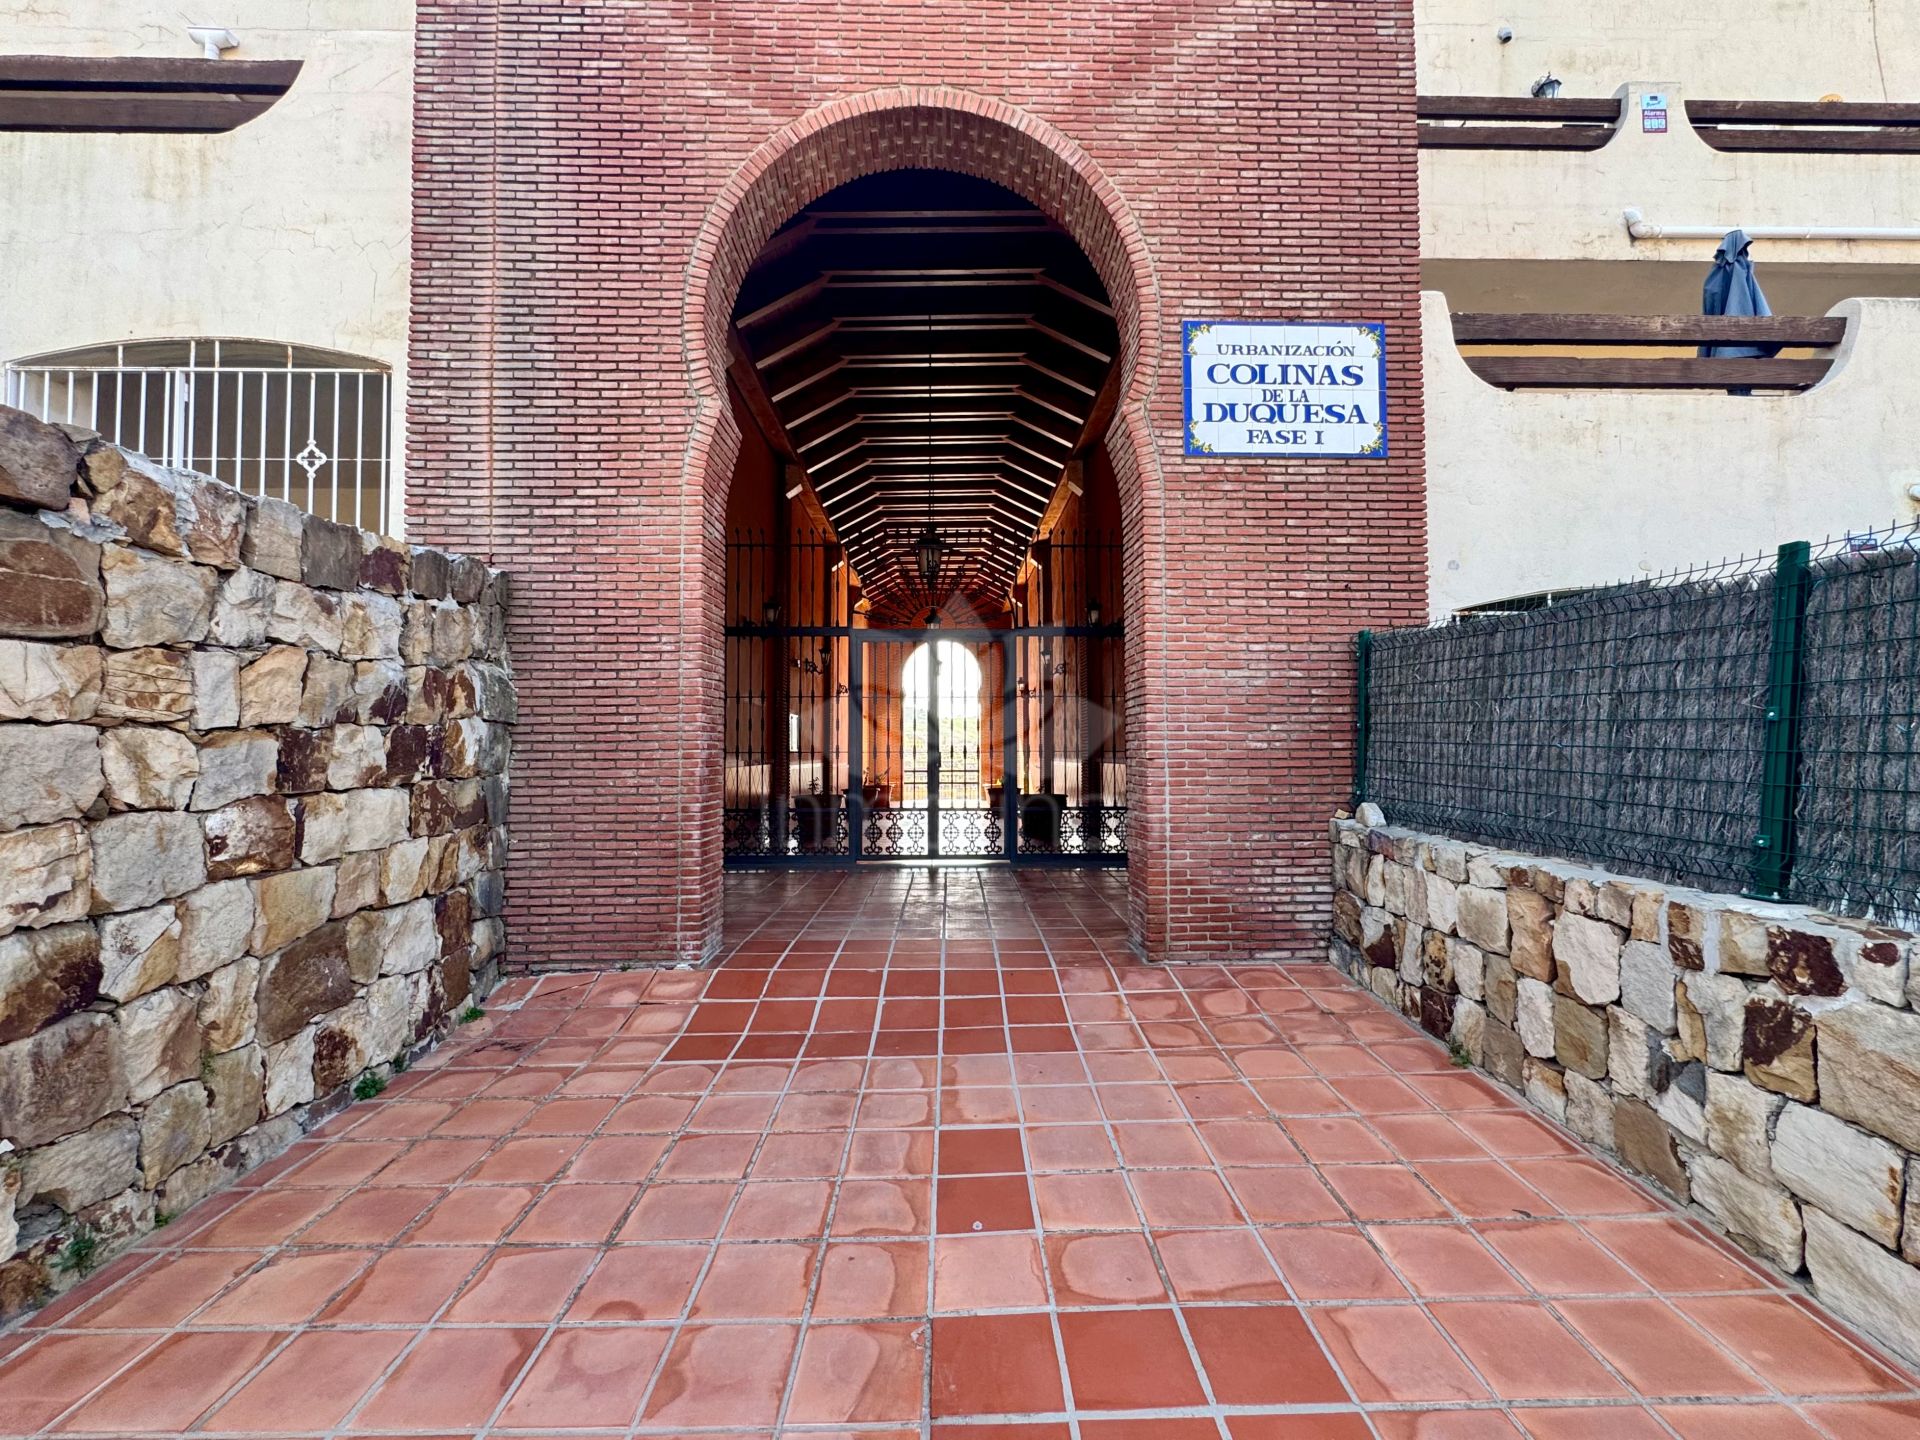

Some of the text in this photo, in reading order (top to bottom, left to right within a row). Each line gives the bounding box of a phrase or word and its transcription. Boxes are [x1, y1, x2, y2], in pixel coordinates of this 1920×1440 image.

[1216, 341, 1356, 357] URBANIZACIÓN
[1207, 363, 1364, 386] COLINAS
[1262, 389, 1310, 403] DE LA
[1202, 402, 1369, 425] DUQUESA
[1246, 429, 1325, 445] FASE I
